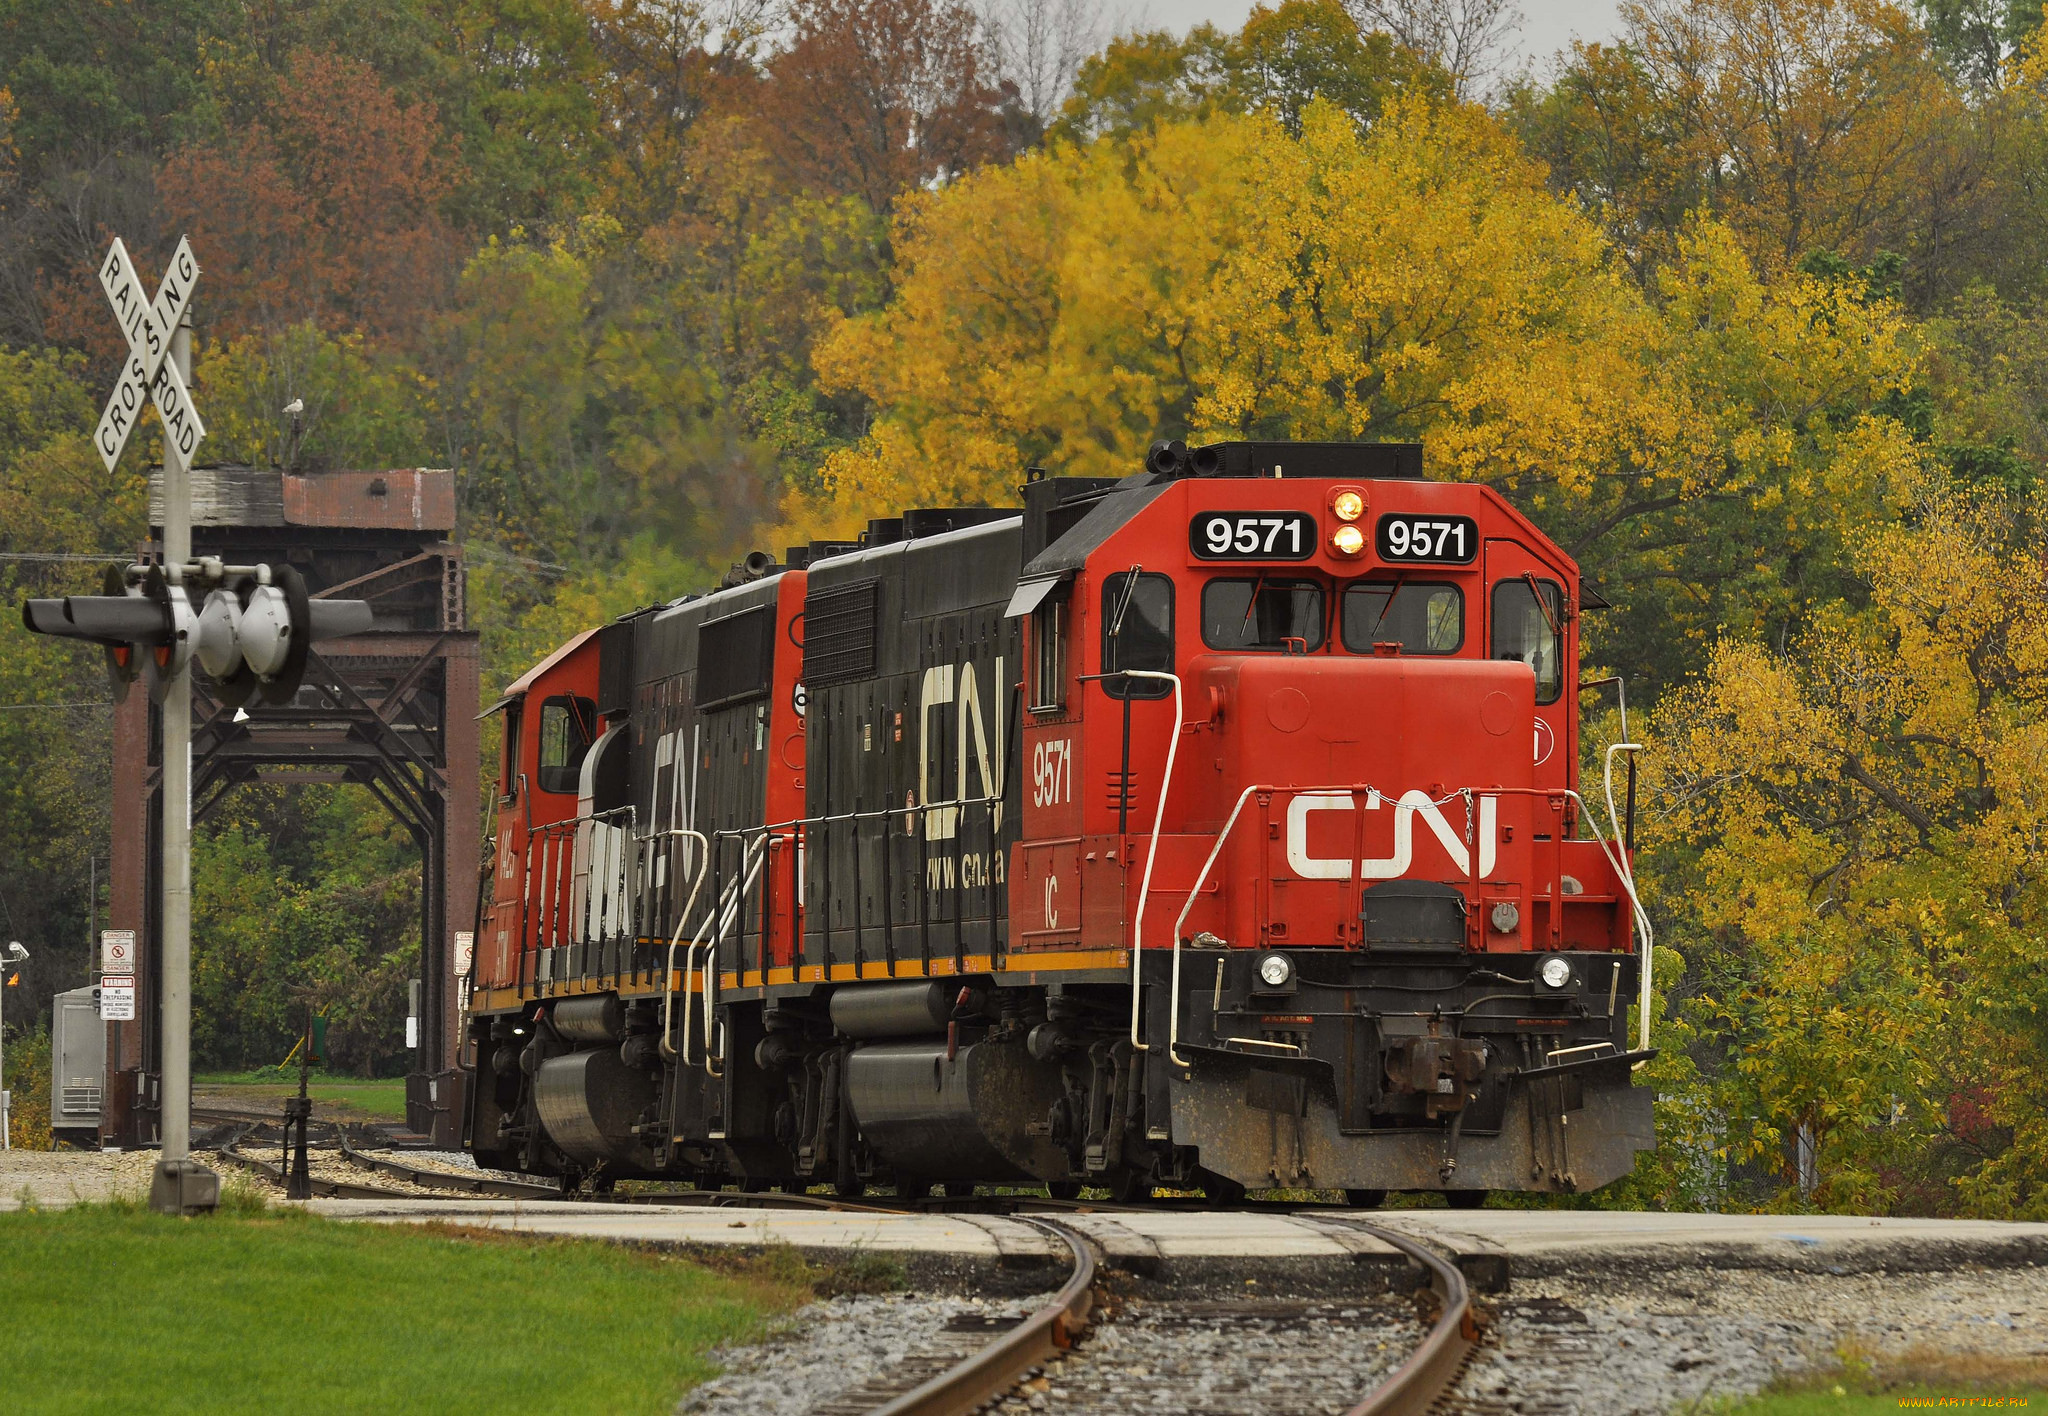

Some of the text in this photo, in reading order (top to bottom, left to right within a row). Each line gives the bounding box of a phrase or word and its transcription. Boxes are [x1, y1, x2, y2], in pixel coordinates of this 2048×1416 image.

[101, 252, 192, 456] CROSSING
[1206, 518, 1301, 553] 9571
[1388, 520, 1465, 557] 9571
[919, 656, 1004, 841] CN
[1033, 738, 1071, 808] 9571
[648, 723, 699, 889] CN
[1286, 790, 1497, 879] CN
[1045, 875, 1058, 930] IC
